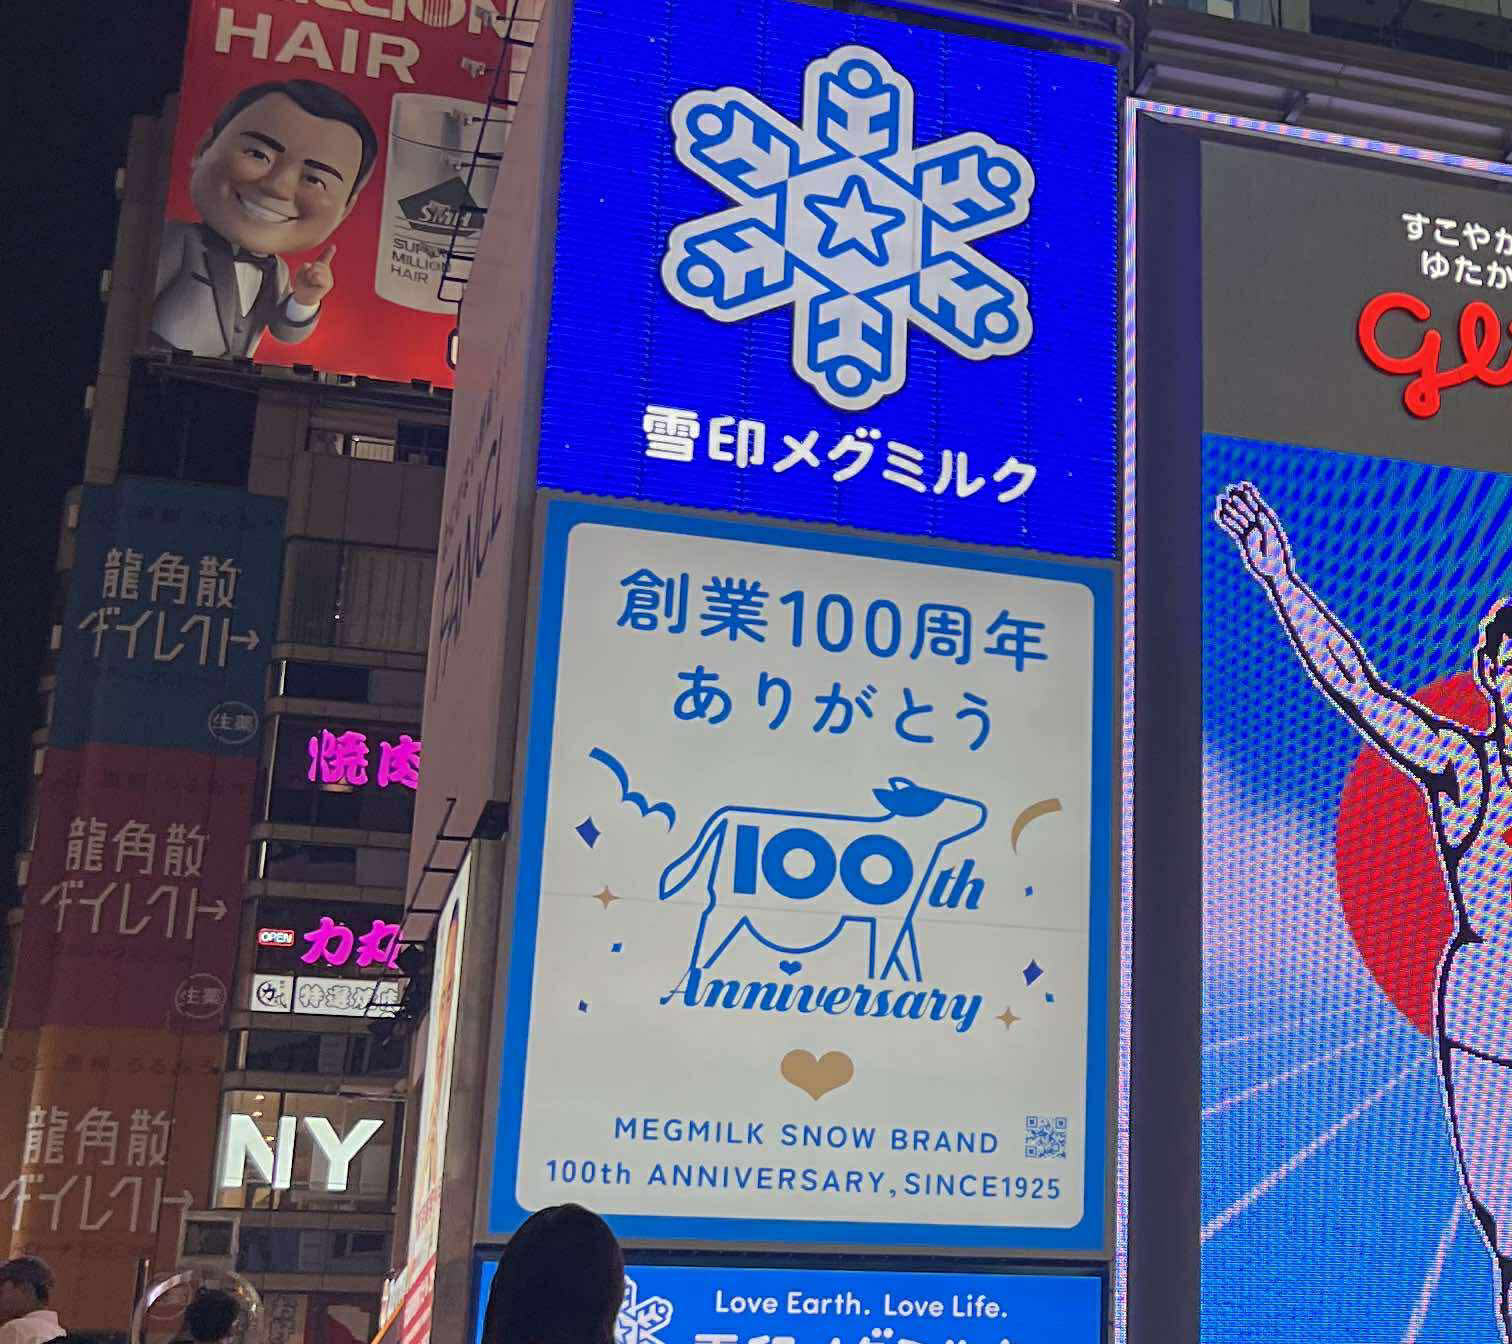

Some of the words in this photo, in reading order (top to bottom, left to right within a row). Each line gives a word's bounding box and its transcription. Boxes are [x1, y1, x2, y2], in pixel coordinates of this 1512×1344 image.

[214, 7, 420, 85] HAIR
[391, 264, 429, 285] HAIR
[642, 404, 1038, 504] 雪印メグミルク
[102, 546, 242, 609] 龍角散
[616, 567, 1049, 672] 創業100周年
[672, 664, 992, 751] ありがとう
[64, 817, 210, 877] 龍角散
[261, 932, 293, 944] OPEN
[660, 959, 984, 1033] Anniversary
[23, 1105, 175, 1167] 龍角散
[223, 1113, 384, 1190] NY
[614, 1117, 764, 1145] MEGMILK
[781, 1123, 876, 1151] SNOW
[891, 1128, 998, 1154] BRAND
[547, 1159, 631, 1185] 100th
[716, 1290, 778, 1313] Love
[788, 1291, 871, 1315] Earth.
[884, 1294, 944, 1317] Love
[952, 1295, 1008, 1318] Life.
